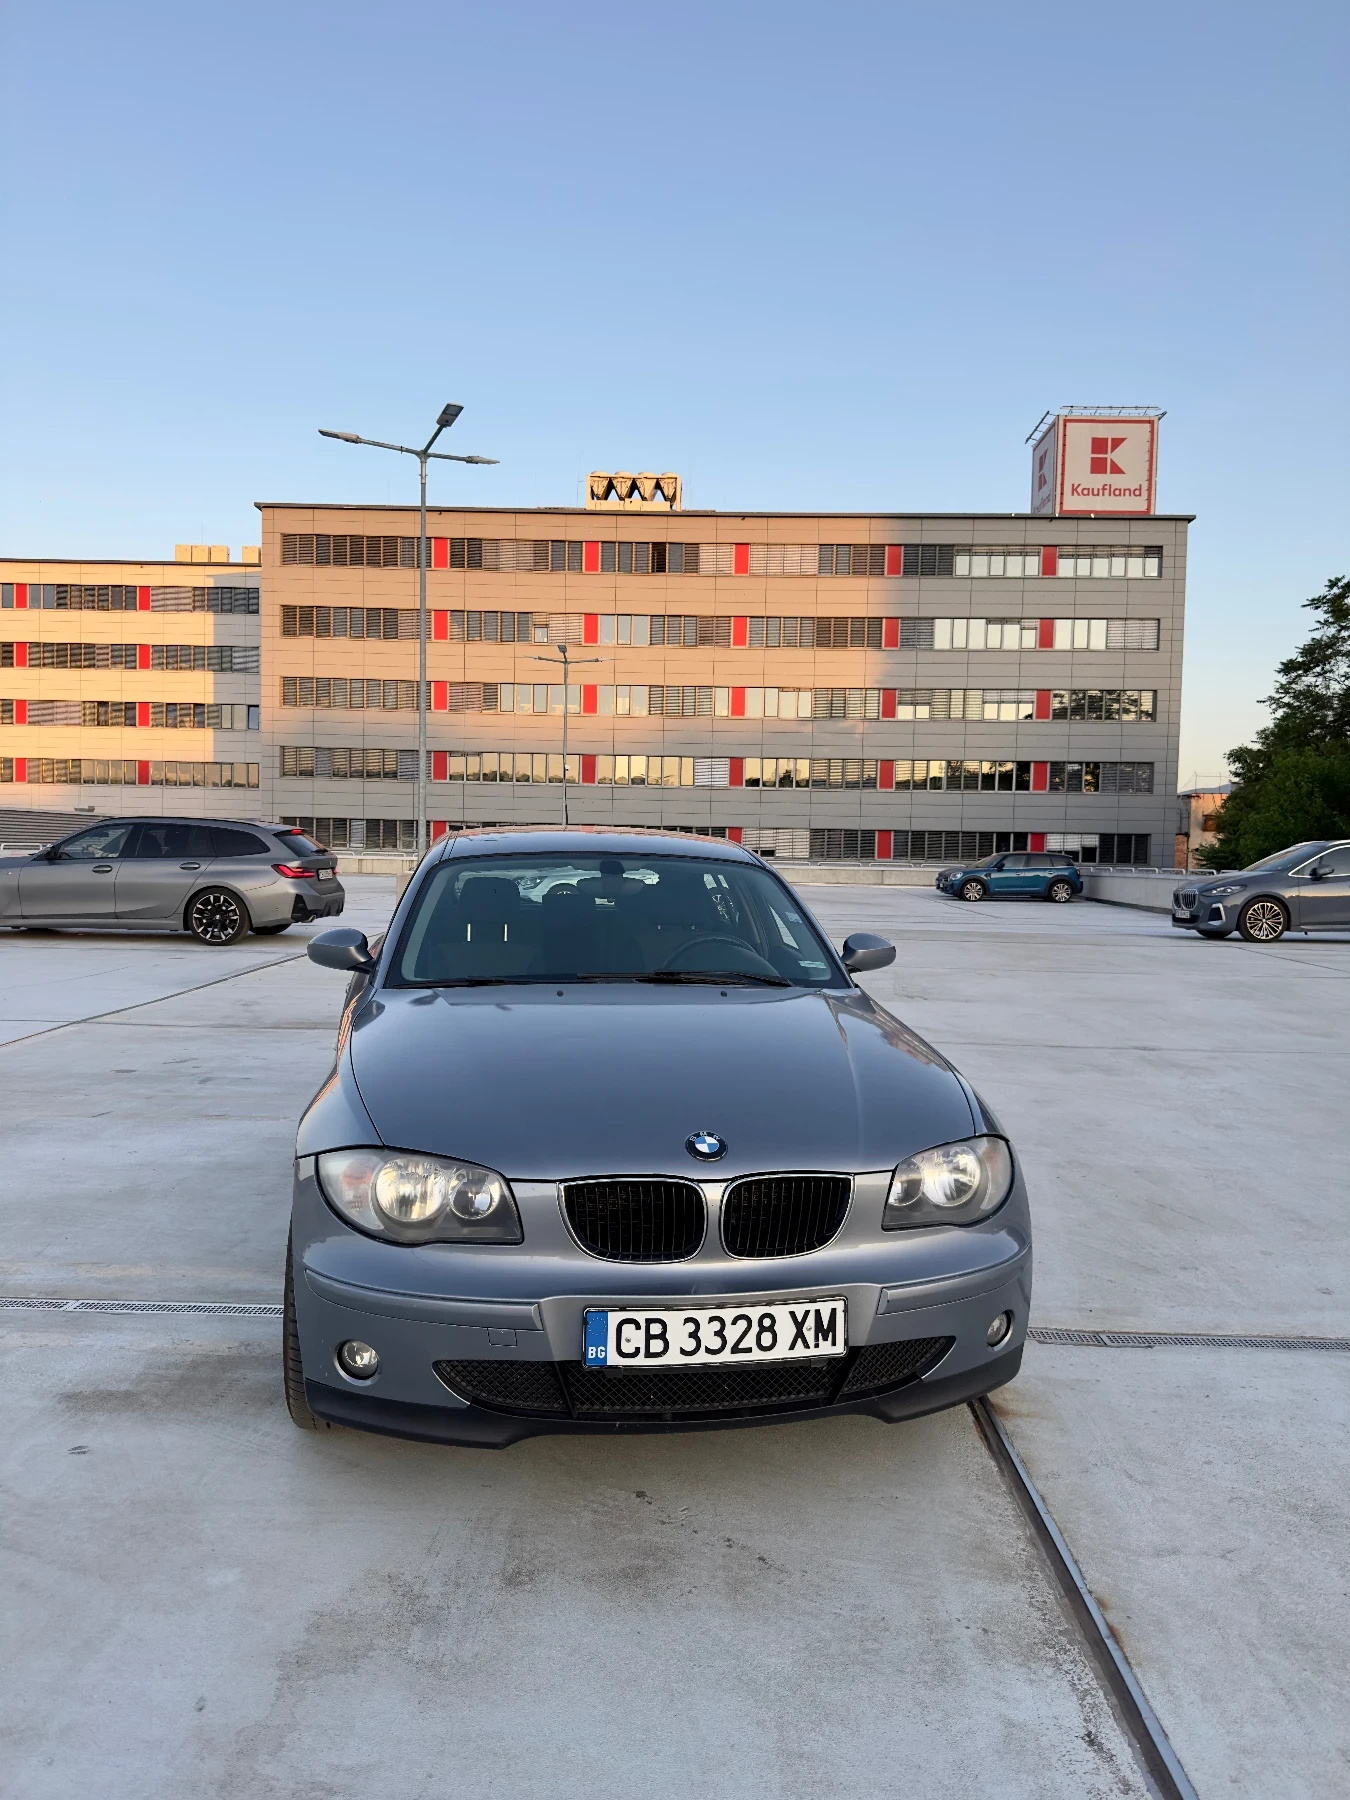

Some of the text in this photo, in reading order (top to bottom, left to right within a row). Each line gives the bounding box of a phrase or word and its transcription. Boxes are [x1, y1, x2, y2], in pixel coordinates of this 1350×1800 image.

[1090, 437, 1128, 475] K
[1071, 483, 1142, 497] Kaufland
[615, 1307, 838, 1359] CB 3328 XM
[588, 1345, 606, 1359] BG
